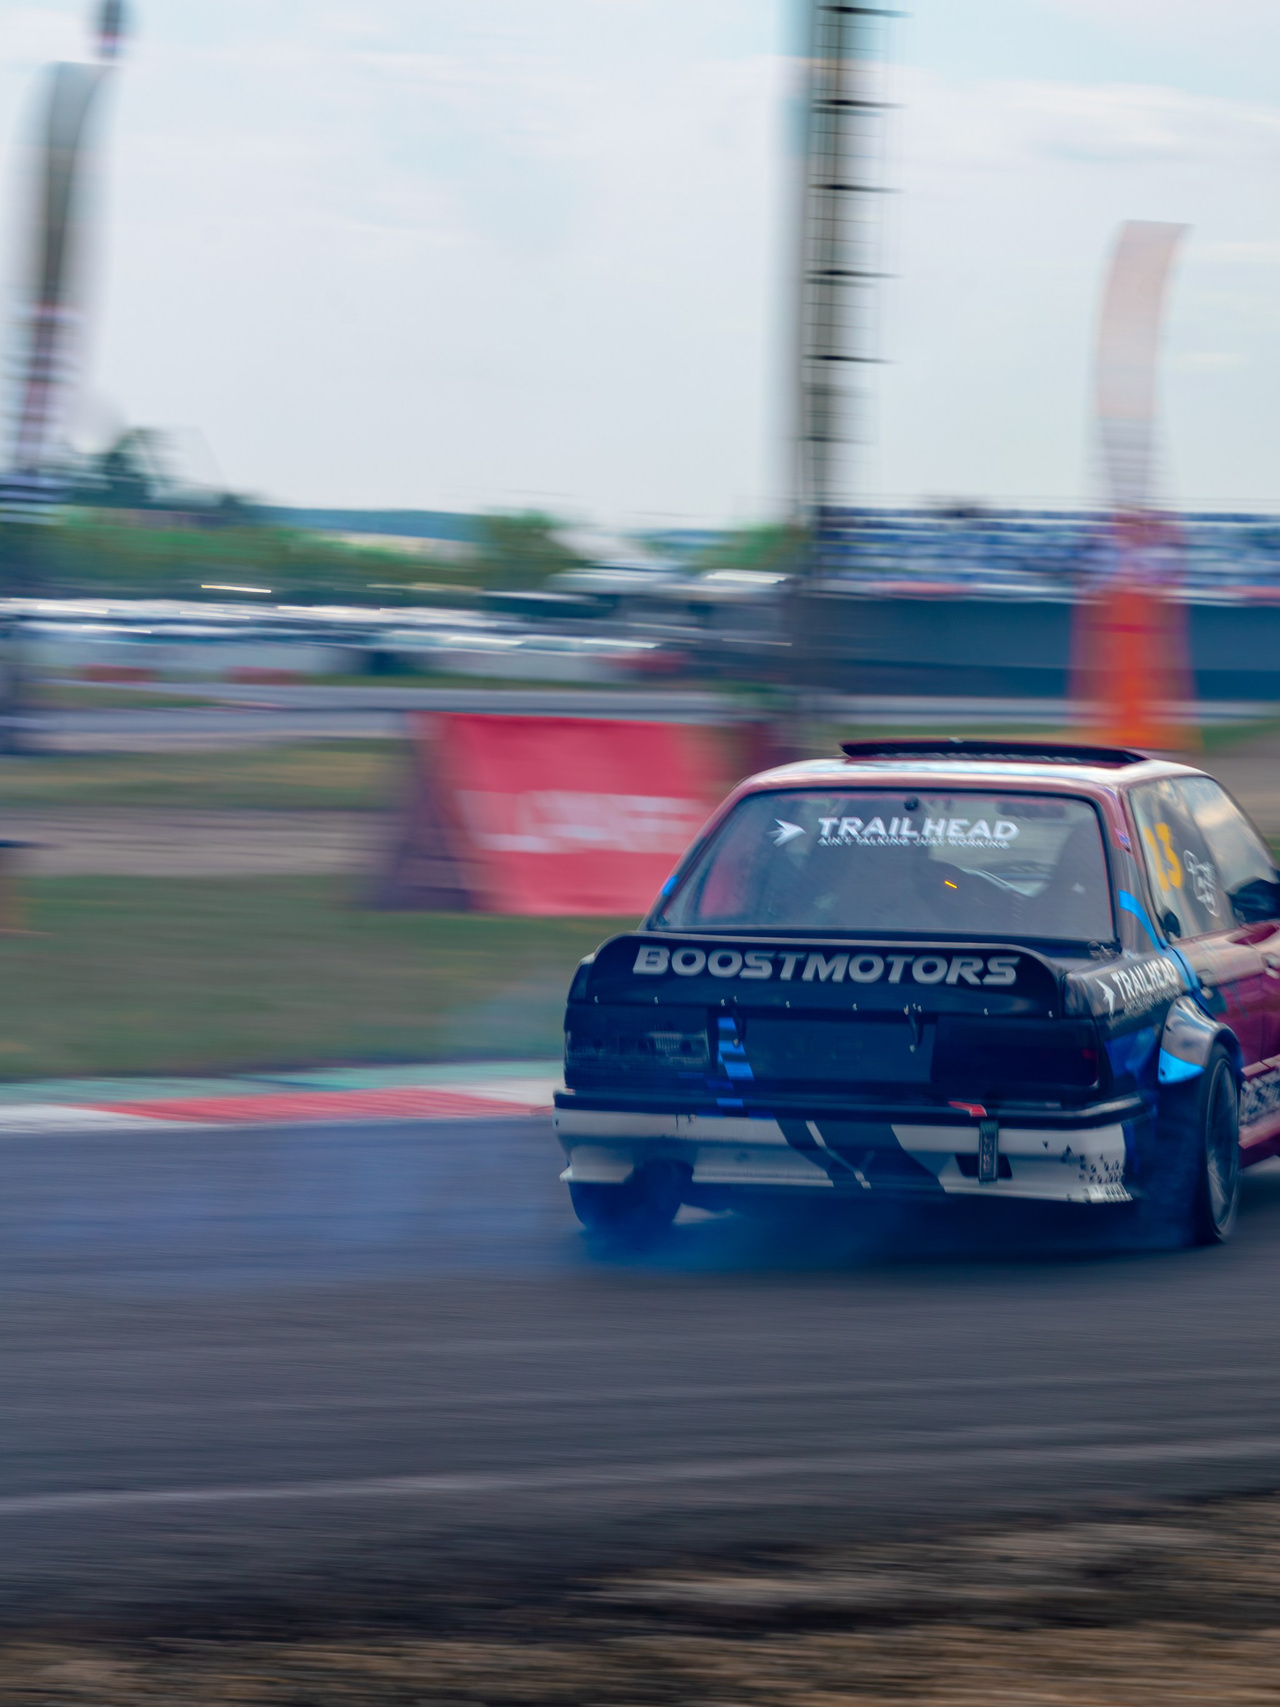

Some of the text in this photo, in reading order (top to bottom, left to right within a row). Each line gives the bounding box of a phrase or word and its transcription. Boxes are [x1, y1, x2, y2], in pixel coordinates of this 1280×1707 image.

[817, 816, 1020, 841] TRAILHEAD
[1143, 821, 1184, 892] 13
[632, 944, 1021, 985] BOOSTMOTORS
[1110, 957, 1180, 1003] TRAILHEAD
